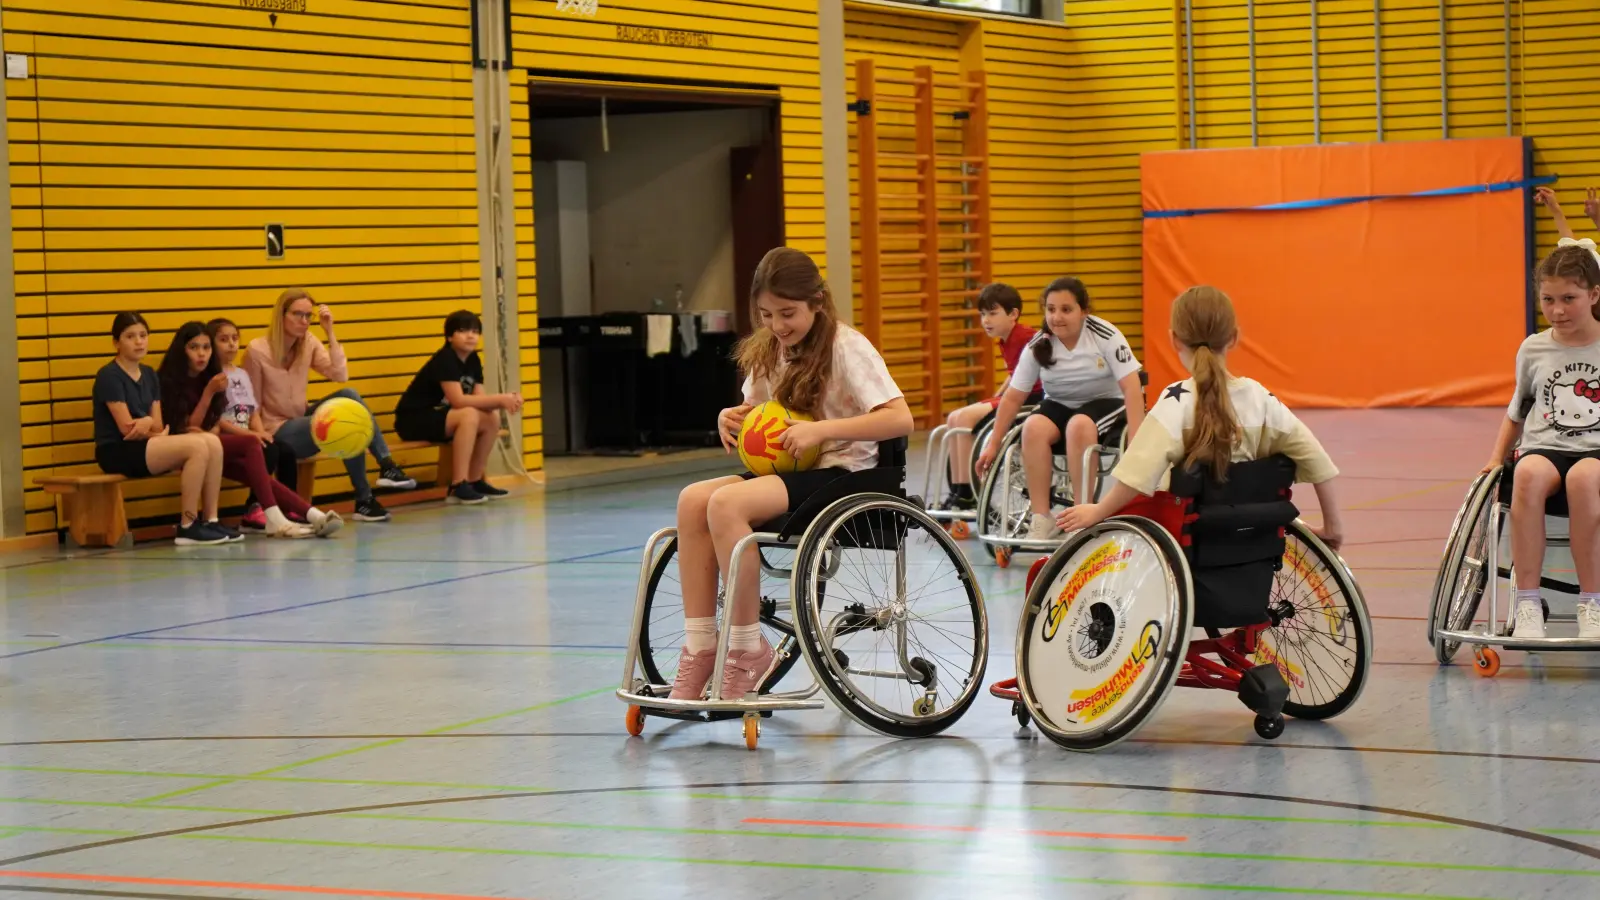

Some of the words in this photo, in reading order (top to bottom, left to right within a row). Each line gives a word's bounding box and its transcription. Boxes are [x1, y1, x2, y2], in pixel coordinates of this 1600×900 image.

[616, 25, 660, 43] RAUCHEN
[1543, 371, 1562, 405] HELLO
[1565, 363, 1598, 374] KITTY
[1067, 657, 1133, 713] Mühleisen
